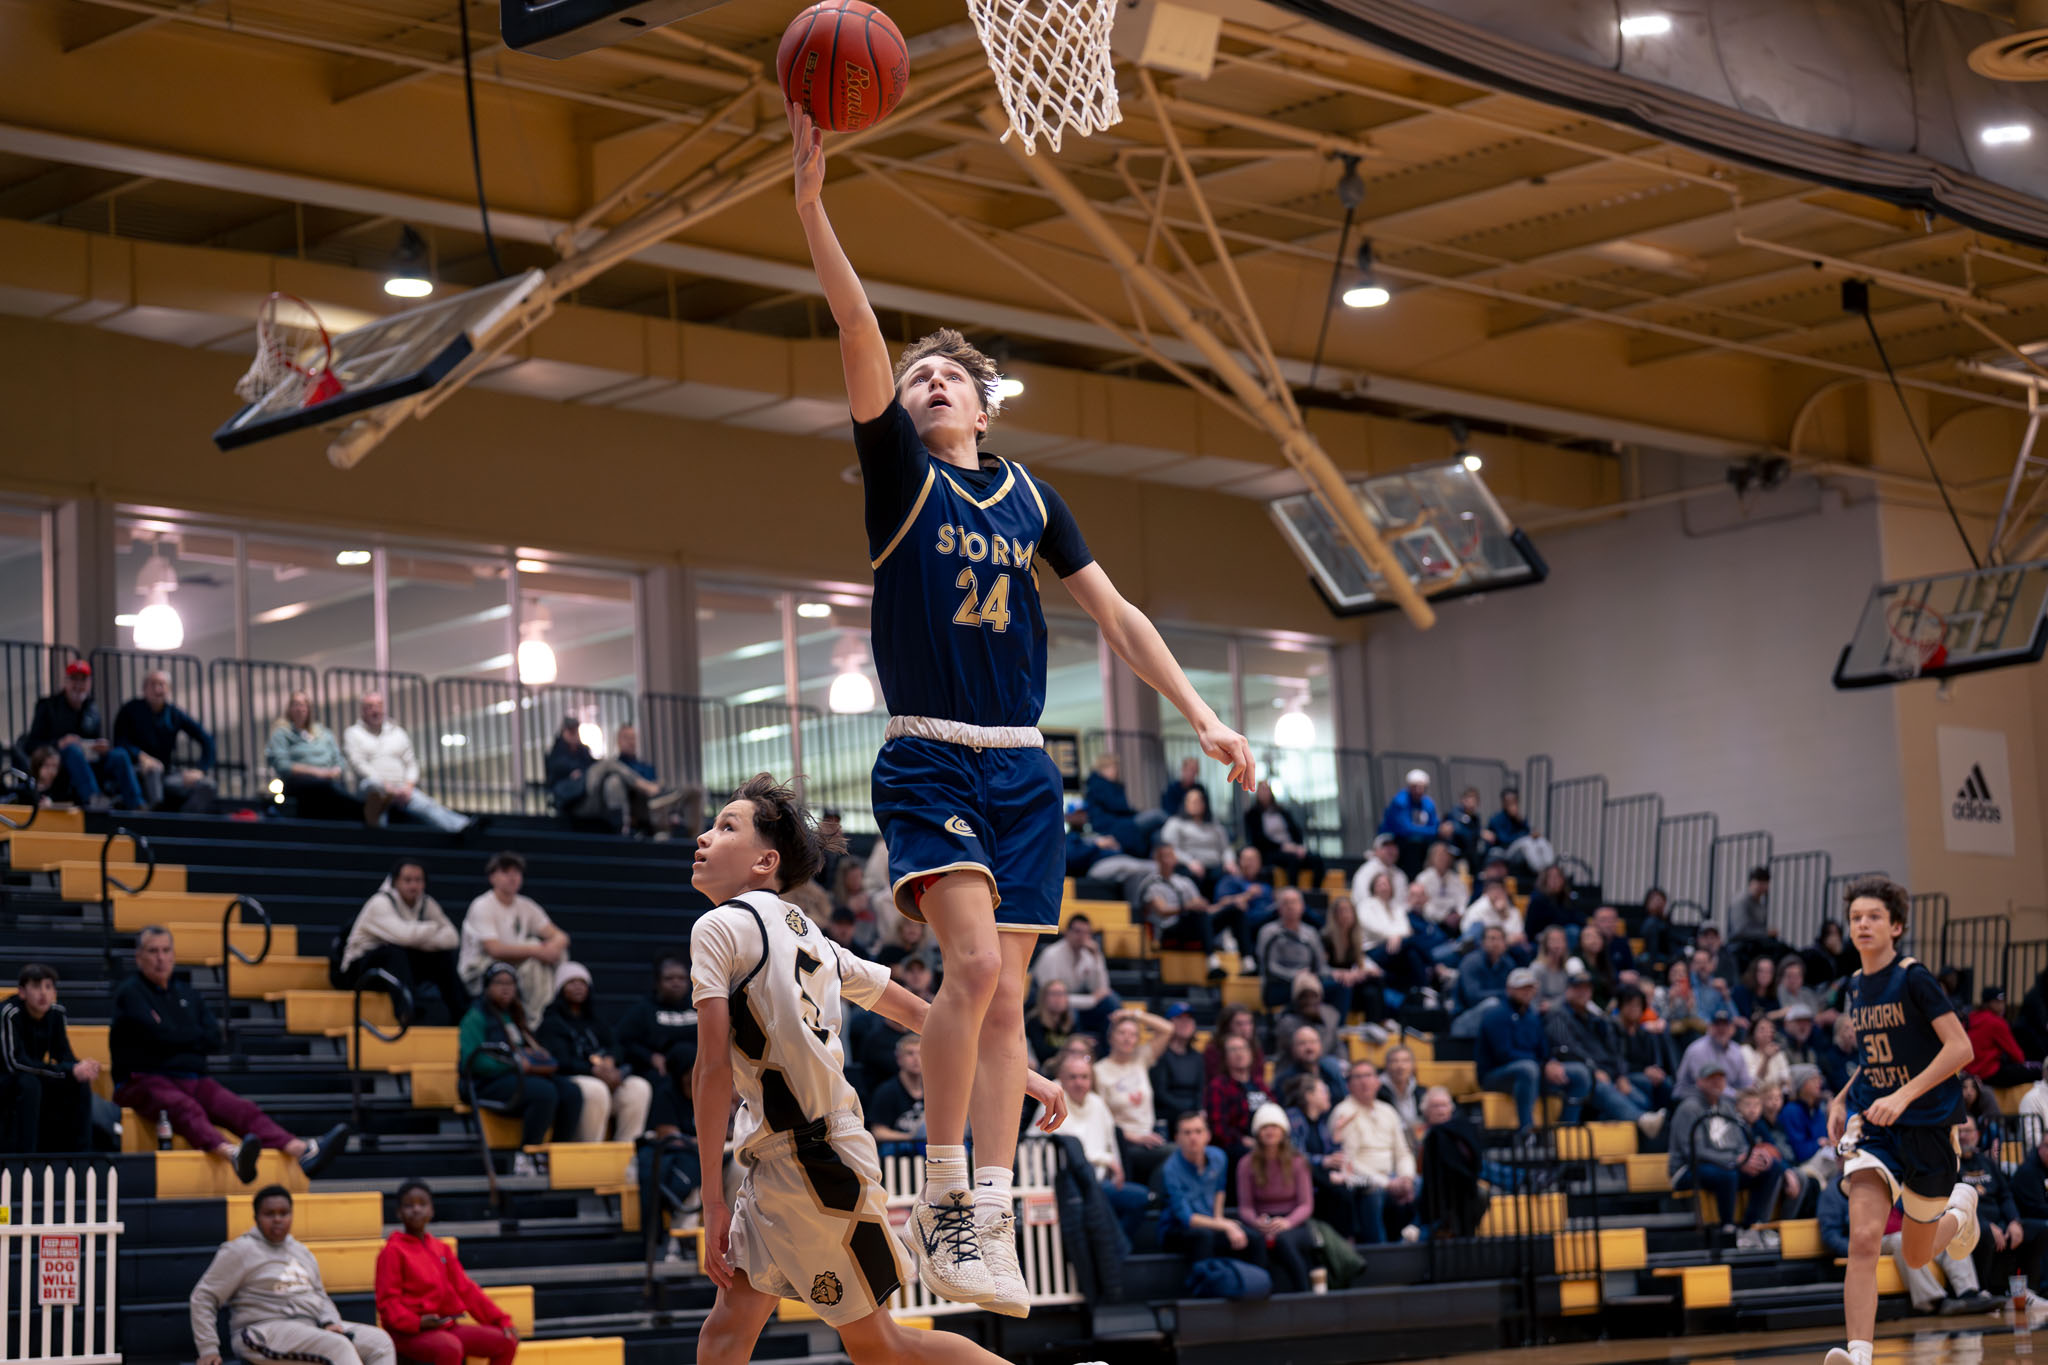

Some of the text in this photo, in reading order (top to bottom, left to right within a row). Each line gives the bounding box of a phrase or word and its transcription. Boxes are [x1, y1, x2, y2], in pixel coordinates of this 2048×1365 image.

[935, 523, 1034, 571] STORM
[952, 566, 1011, 633] 24
[1952, 801, 2001, 824] adidas
[795, 946, 830, 1046] 5
[1863, 1032, 1894, 1064] 30
[43, 1274, 77, 1286] WILL
[45, 1261, 75, 1273] DOG
[43, 1287, 76, 1299] BITE
